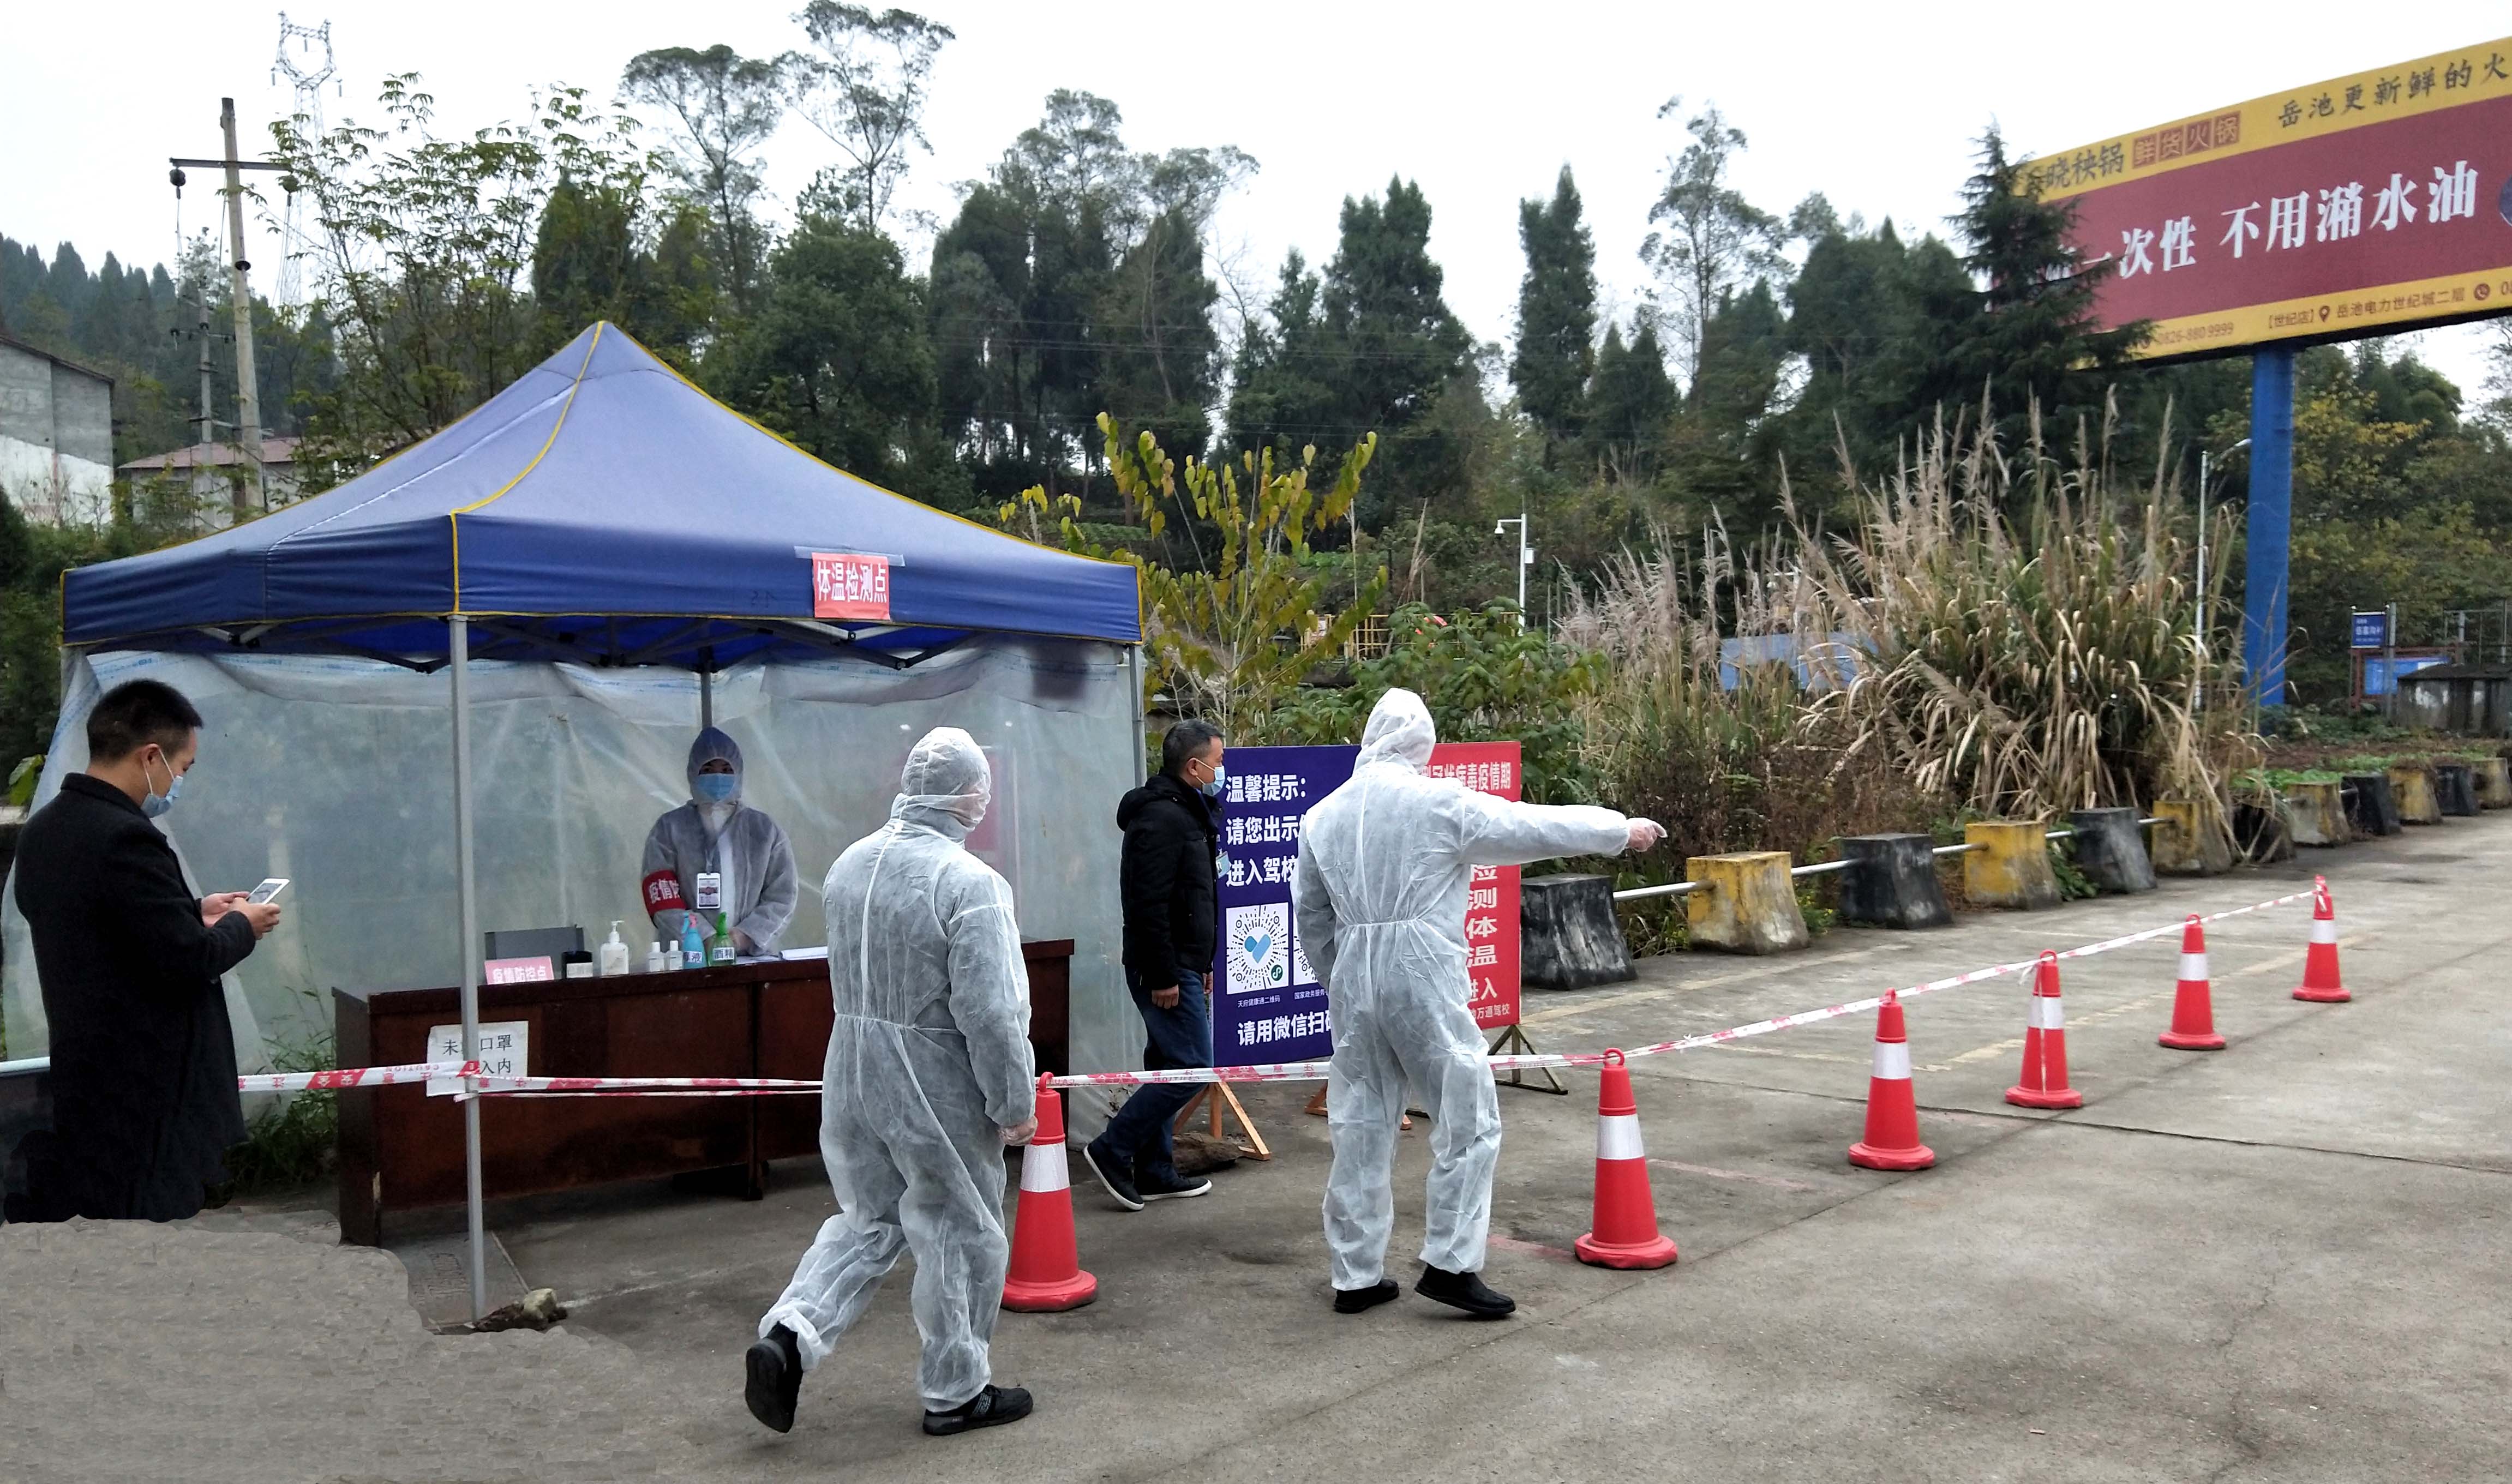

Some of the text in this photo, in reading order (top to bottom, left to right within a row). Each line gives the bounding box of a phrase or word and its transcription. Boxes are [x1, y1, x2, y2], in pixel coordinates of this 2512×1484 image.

[2278, 53, 2509, 128] 岳池更新鲜的火
[2043, 215, 2196, 281] 一次性
[817, 561, 887, 603] 体温检测点
[493, 965, 546, 984] 疫情防控点
[1294, 988, 1329, 1000] 国家政务服务
[443, 1034, 512, 1056] 未口罩
